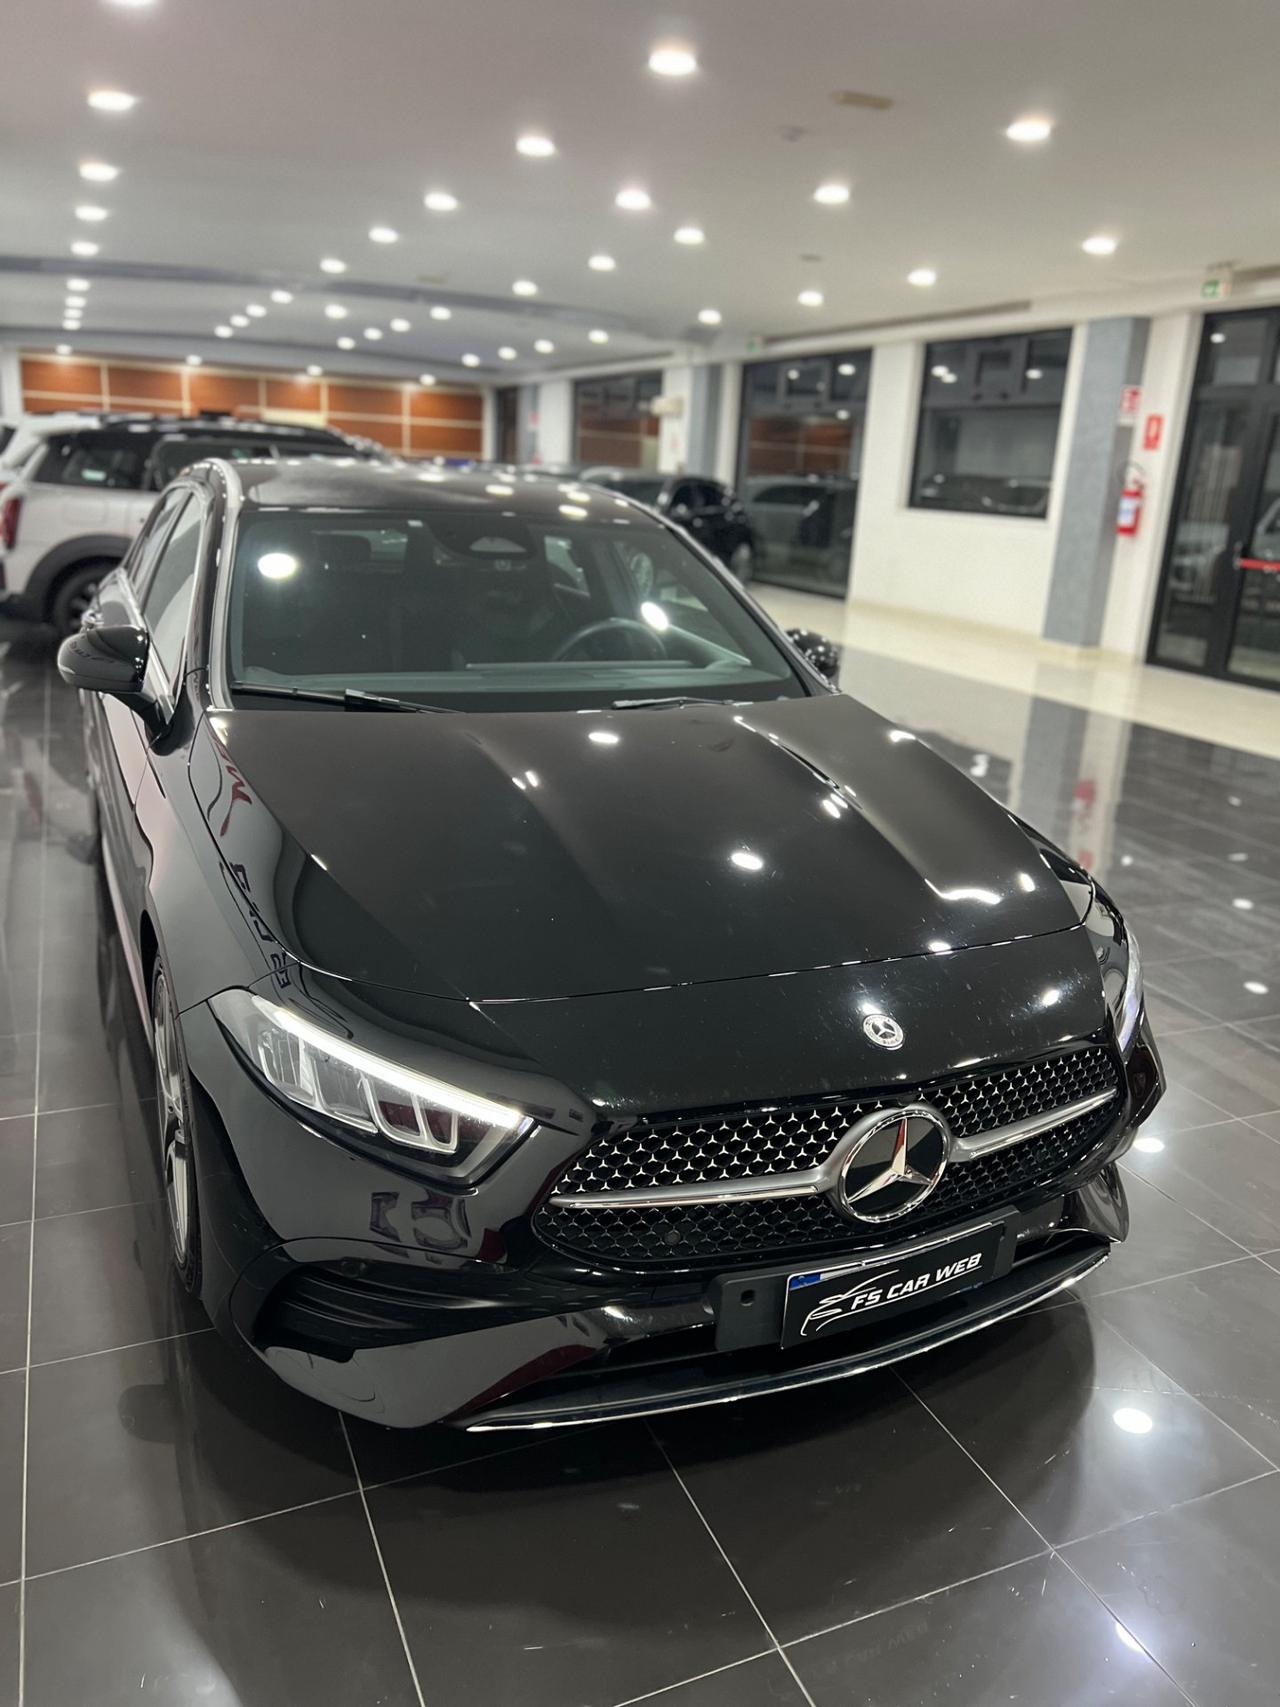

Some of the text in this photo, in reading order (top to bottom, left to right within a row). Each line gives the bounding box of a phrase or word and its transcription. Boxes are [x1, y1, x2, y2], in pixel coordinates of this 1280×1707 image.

[851, 1253, 983, 1311] FS CAR WEB
